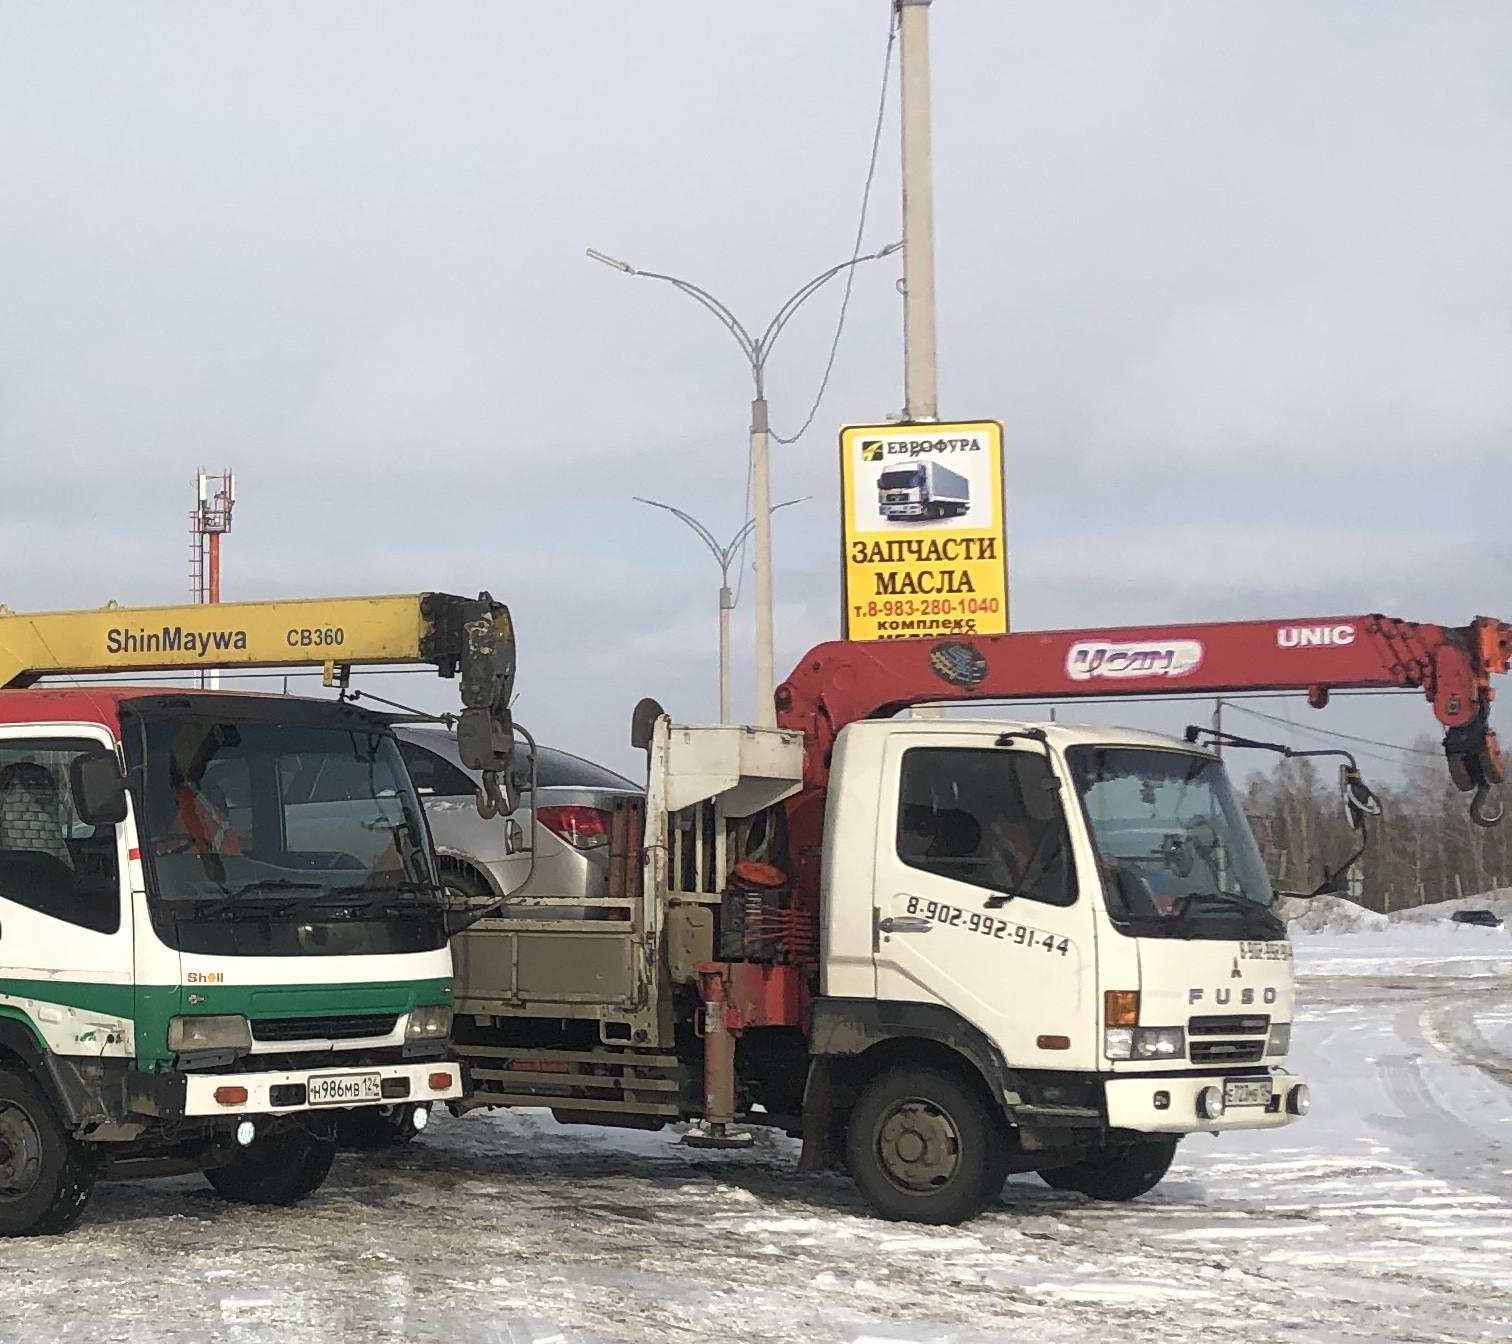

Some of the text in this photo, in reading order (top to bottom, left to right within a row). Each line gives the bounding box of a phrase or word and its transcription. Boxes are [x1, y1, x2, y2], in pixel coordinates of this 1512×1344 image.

[887, 439, 981, 455] ЕВРОФУРА
[852, 537, 998, 564] ЗАПЧАСТИ
[874, 570, 976, 596] МАСЛА
[877, 618, 977, 631] комплекс
[1277, 625, 1356, 647] UNIC
[106, 627, 345, 657] ShinMaywa CB360
[906, 896, 1070, 956] 8-902-992-91-44
[1188, 987, 1277, 1005] FUSO
